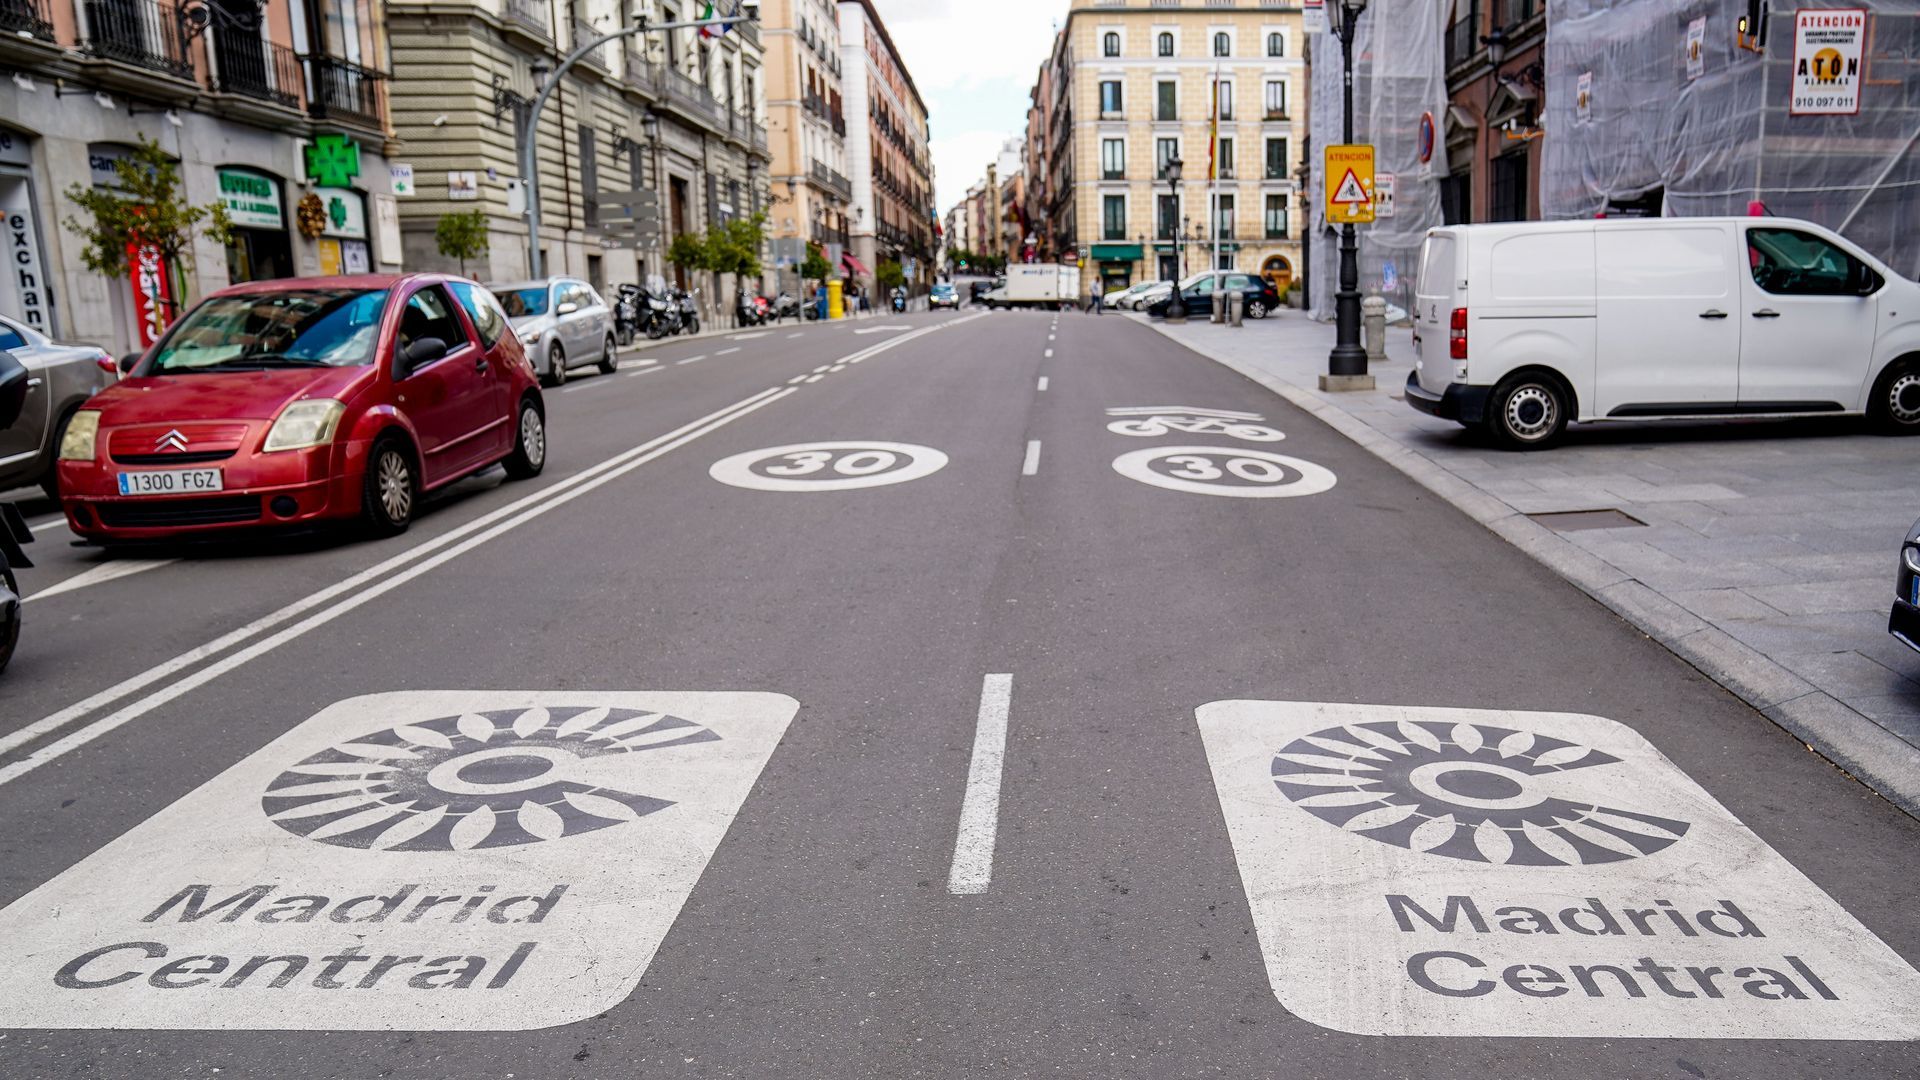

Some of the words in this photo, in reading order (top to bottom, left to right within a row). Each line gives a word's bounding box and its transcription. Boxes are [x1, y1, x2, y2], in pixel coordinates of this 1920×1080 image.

[1801, 15, 1861, 27] ATENCIÓN
[1798, 55, 1857, 76] ATÓN
[1795, 97, 1814, 107] 910
[1816, 97, 1834, 107] 097
[1837, 97, 1854, 107] 011
[10, 214, 43, 333] exchan
[766, 451, 896, 475] 30
[1165, 455, 1284, 482] 30
[132, 474, 173, 491] 1300
[182, 471, 215, 488] FGZ
[140, 884, 569, 923] Madrid
[1385, 894, 1766, 937] Madrid
[53, 941, 538, 989] Central
[1406, 951, 1839, 1000] Central
